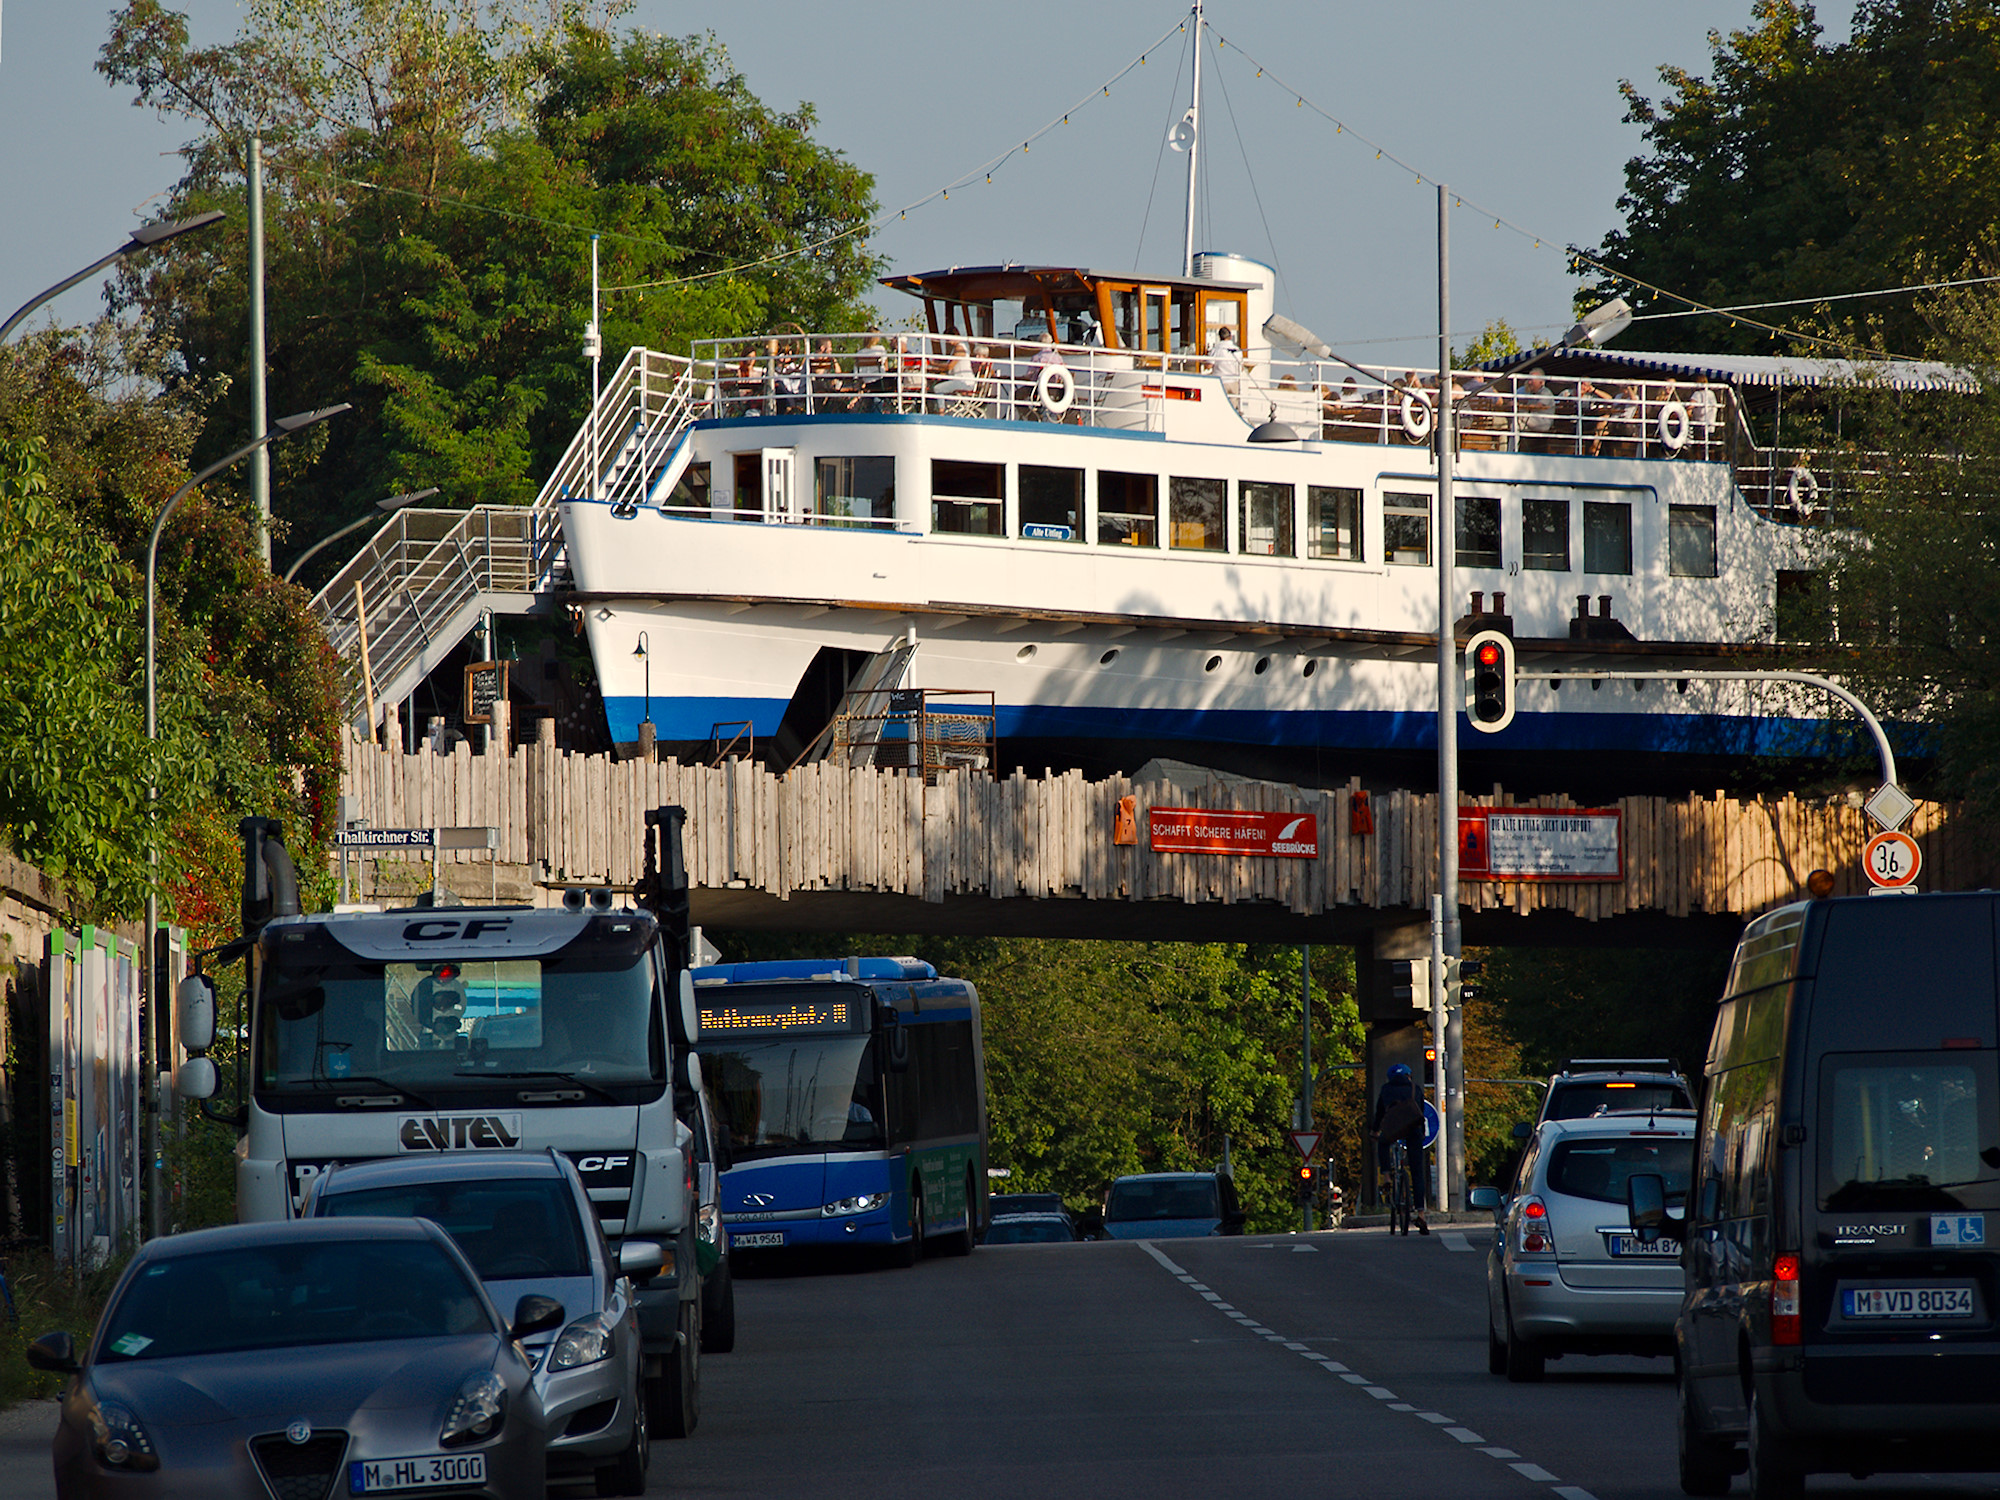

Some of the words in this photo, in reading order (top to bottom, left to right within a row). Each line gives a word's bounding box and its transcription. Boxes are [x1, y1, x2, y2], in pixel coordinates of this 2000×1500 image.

[1032, 527, 1044, 537] Alte
[891, 692, 905, 701] WC
[1152, 823, 1191, 837] SCHAFFT
[1194, 825, 1231, 840] SICHERE
[1234, 825, 1266, 841] HÄFEN!
[1491, 818, 1500, 831] DIE
[1502, 819, 1516, 832] ALTE
[1561, 820, 1568, 832] AB
[1569, 820, 1591, 833] SOFORT
[337, 831, 409, 844] Thalkirchner
[410, 830, 429, 843] Str.
[1271, 841, 1316, 855] SEEBRÜCKE
[1876, 845, 1898, 875] 3,6
[402, 919, 514, 941] CF
[578, 1156, 630, 1172] CF
[735, 1213, 775, 1222] SOLARIS
[1836, 1224, 1908, 1236] TRANSIT
[734, 1237, 741, 1246] M
[745, 1235, 758, 1245] WA
[759, 1234, 782, 1244] 9561
[1621, 1239, 1631, 1252] M
[1857, 1292, 1871, 1312] M
[1885, 1291, 1913, 1311] VD
[1918, 1290, 1970, 1312] 8034
[364, 1464, 380, 1488] M
[395, 1462, 425, 1485] HL
[429, 1457, 482, 1482] 3000
